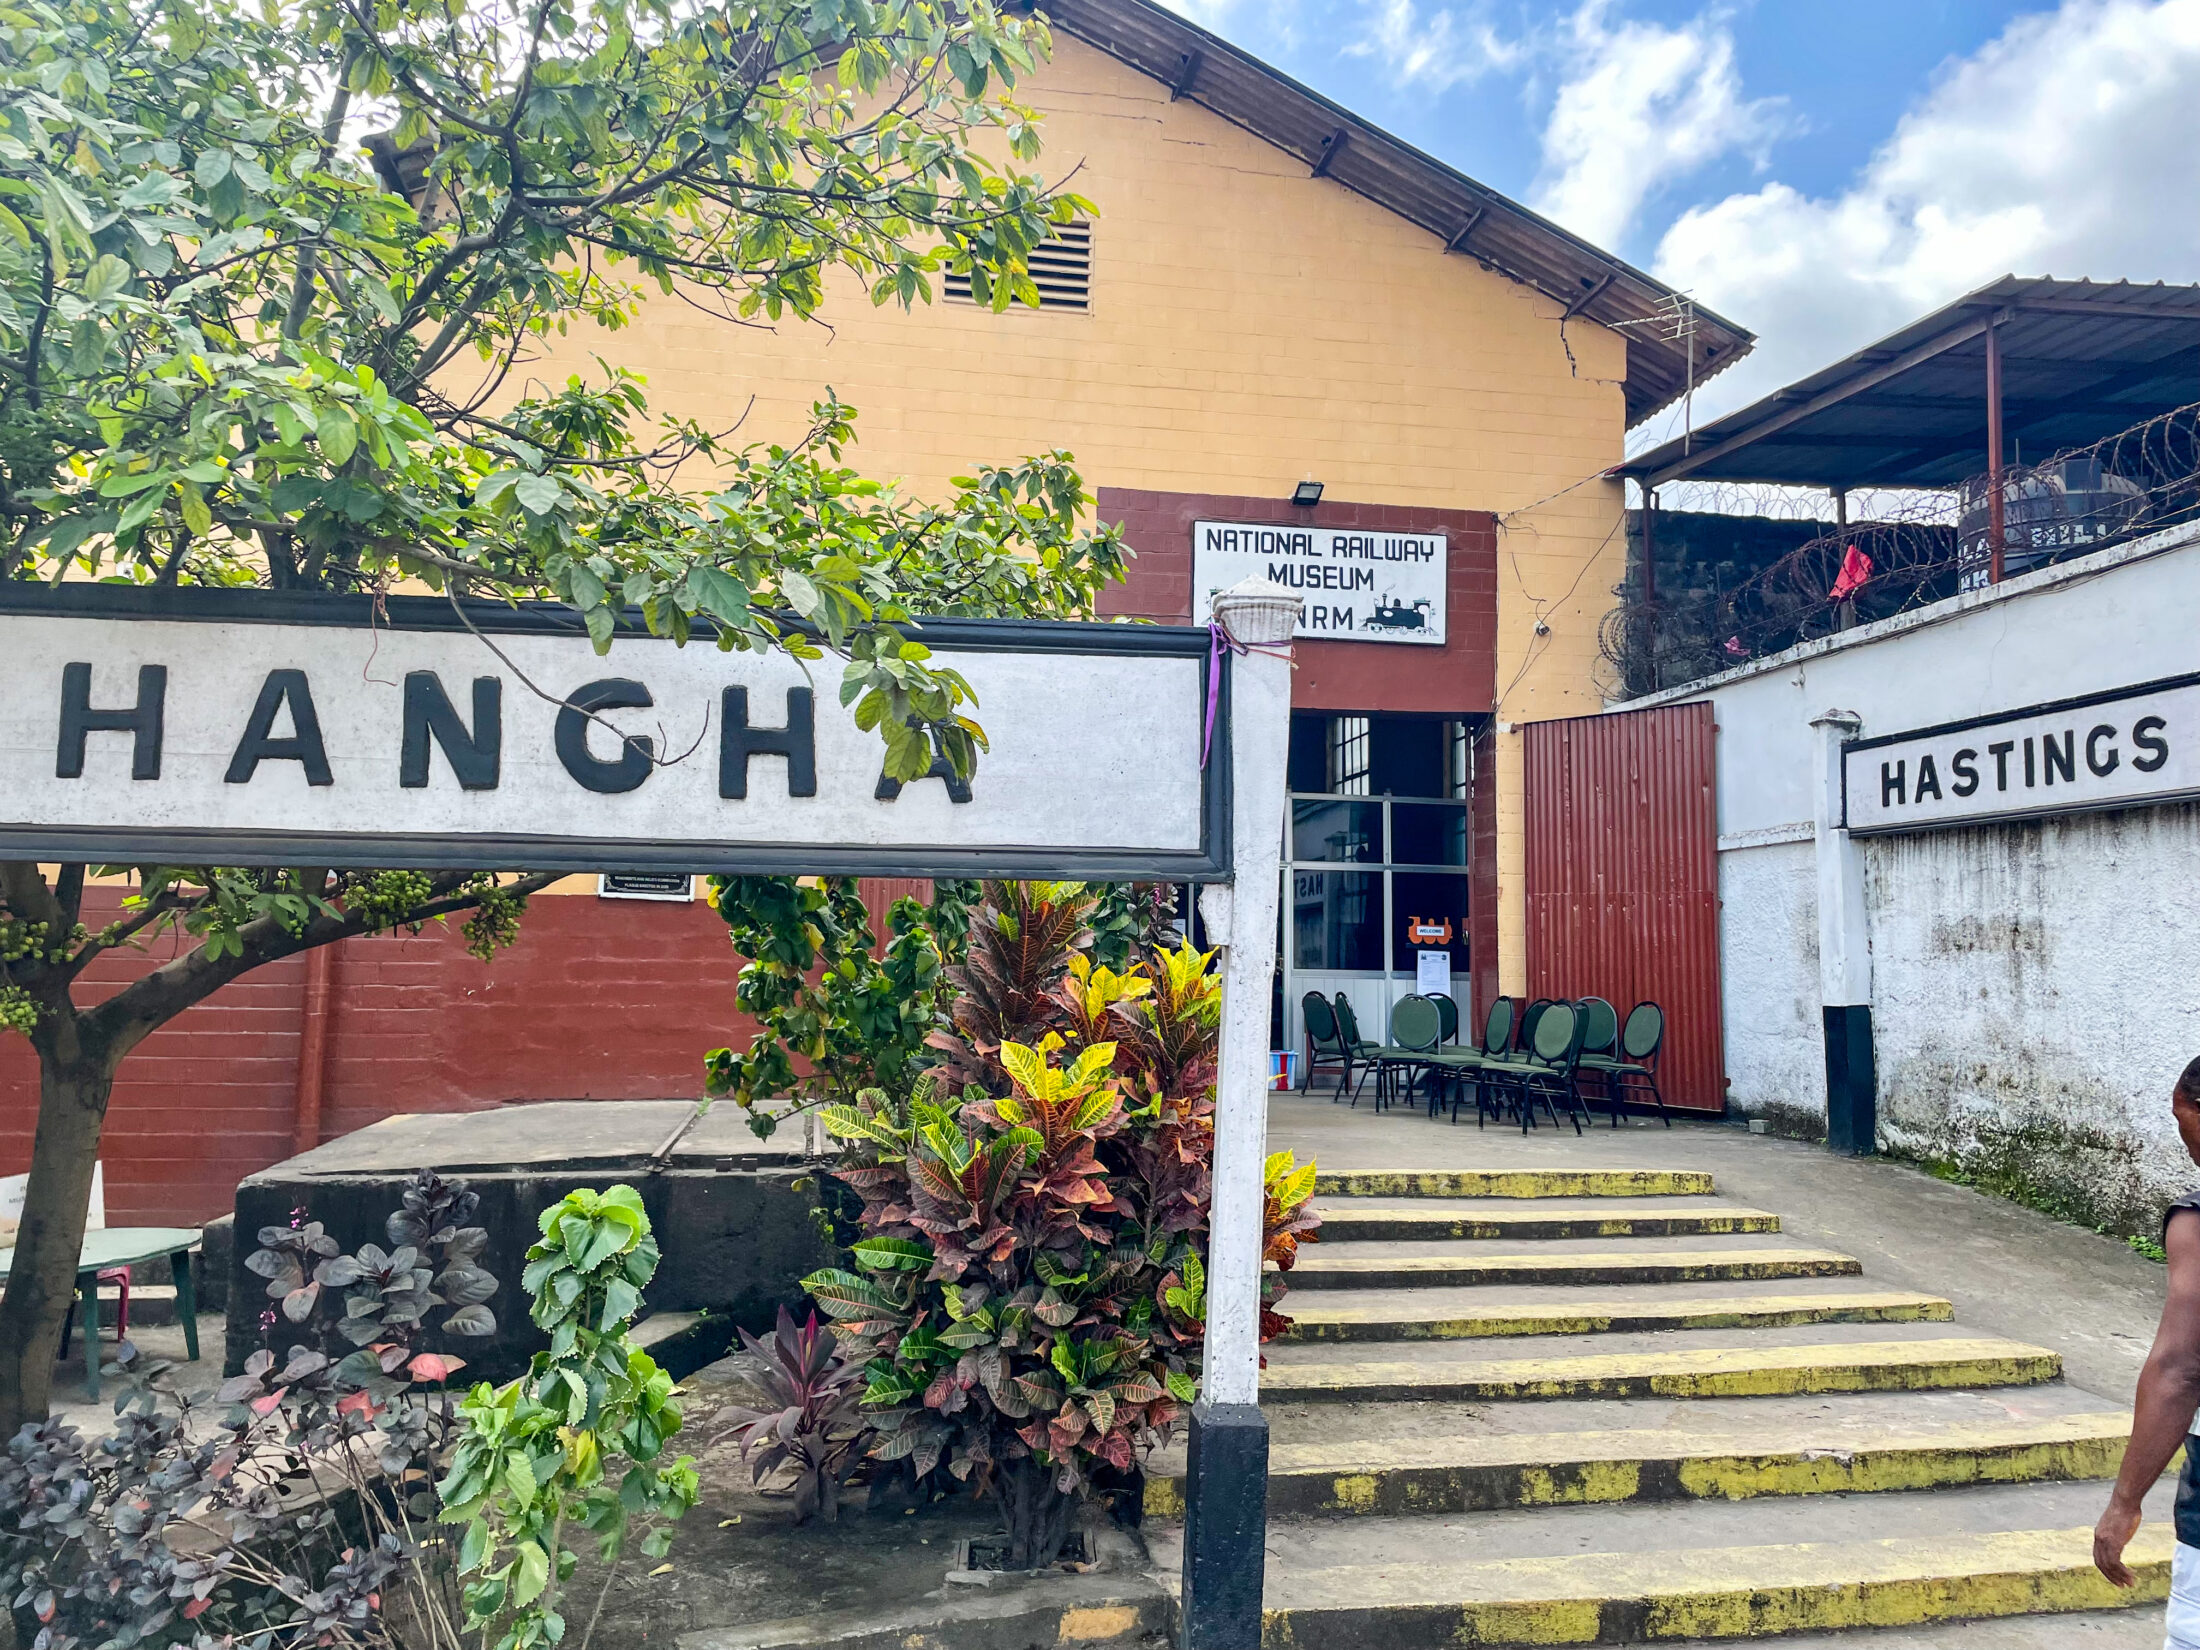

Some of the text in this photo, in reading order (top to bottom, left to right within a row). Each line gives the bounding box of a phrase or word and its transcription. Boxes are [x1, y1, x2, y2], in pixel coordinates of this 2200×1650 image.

[1206, 528, 1434, 563] NATIONAL RAILWAY
[1267, 562, 1375, 591] MUSEUM
[55, 661, 974, 804] HANGHA
[1881, 714, 2170, 808] HASTINGS
